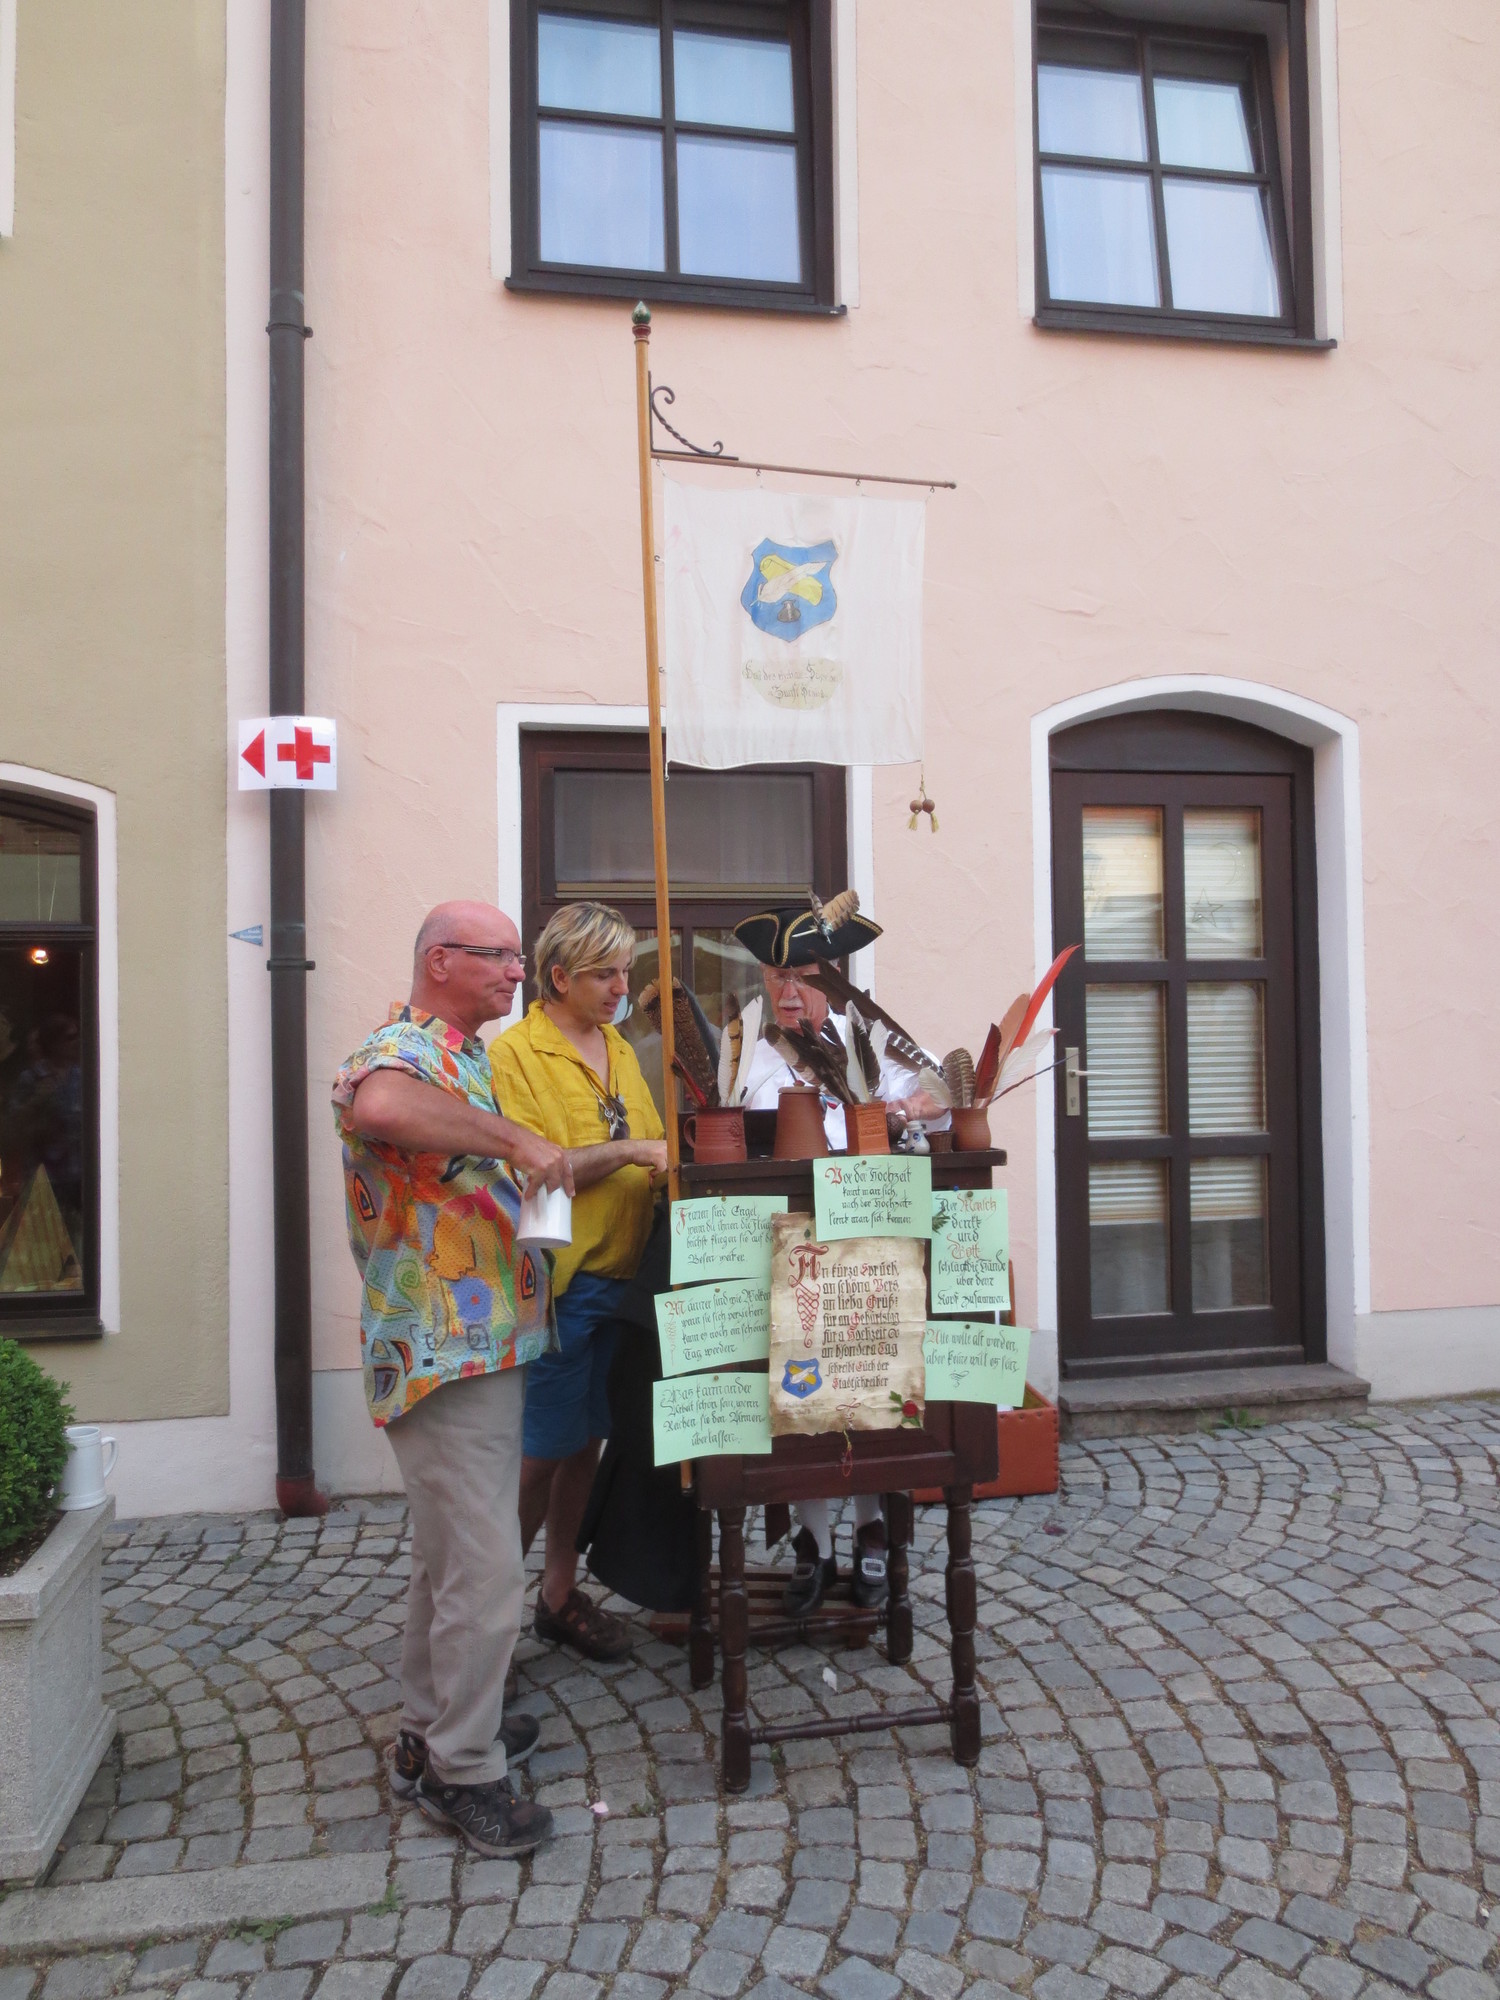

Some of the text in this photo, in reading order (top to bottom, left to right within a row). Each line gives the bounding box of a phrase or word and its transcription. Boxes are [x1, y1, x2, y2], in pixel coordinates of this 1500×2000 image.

[854, 1163, 867, 1183] der
[868, 1162, 912, 1184] Hochzeit
[862, 1187, 880, 1196] man
[842, 1198, 858, 1211] nach
[860, 1198, 871, 1208] der
[676, 1205, 709, 1231] Frauen
[711, 1205, 726, 1220] sind
[851, 1214, 869, 1224] man
[871, 1211, 884, 1228] sich
[951, 1214, 981, 1229] denkt
[706, 1221, 715, 1232] du
[717, 1221, 739, 1234] ihnen
[740, 1218, 751, 1231] die
[739, 1233, 749, 1248] sie
[751, 1234, 763, 1249] auf
[957, 1229, 979, 1242] und
[947, 1234, 980, 1259] Gott
[688, 1253, 715, 1267] Besen
[823, 1282, 835, 1294] an
[956, 1275, 974, 1287] über
[665, 1299, 712, 1316] Männer
[713, 1292, 728, 1309] sind
[823, 1299, 835, 1311] an
[702, 1314, 711, 1329] sie
[712, 1312, 726, 1328] sich
[838, 1316, 850, 1327] an
[709, 1326, 728, 1341] noch
[973, 1330, 984, 1347] alt
[684, 1348, 703, 1362] Tag
[877, 1342, 898, 1358] Tag
[877, 1361, 890, 1372] der
[735, 1377, 752, 1395] der
[700, 1414, 710, 1430] sie
